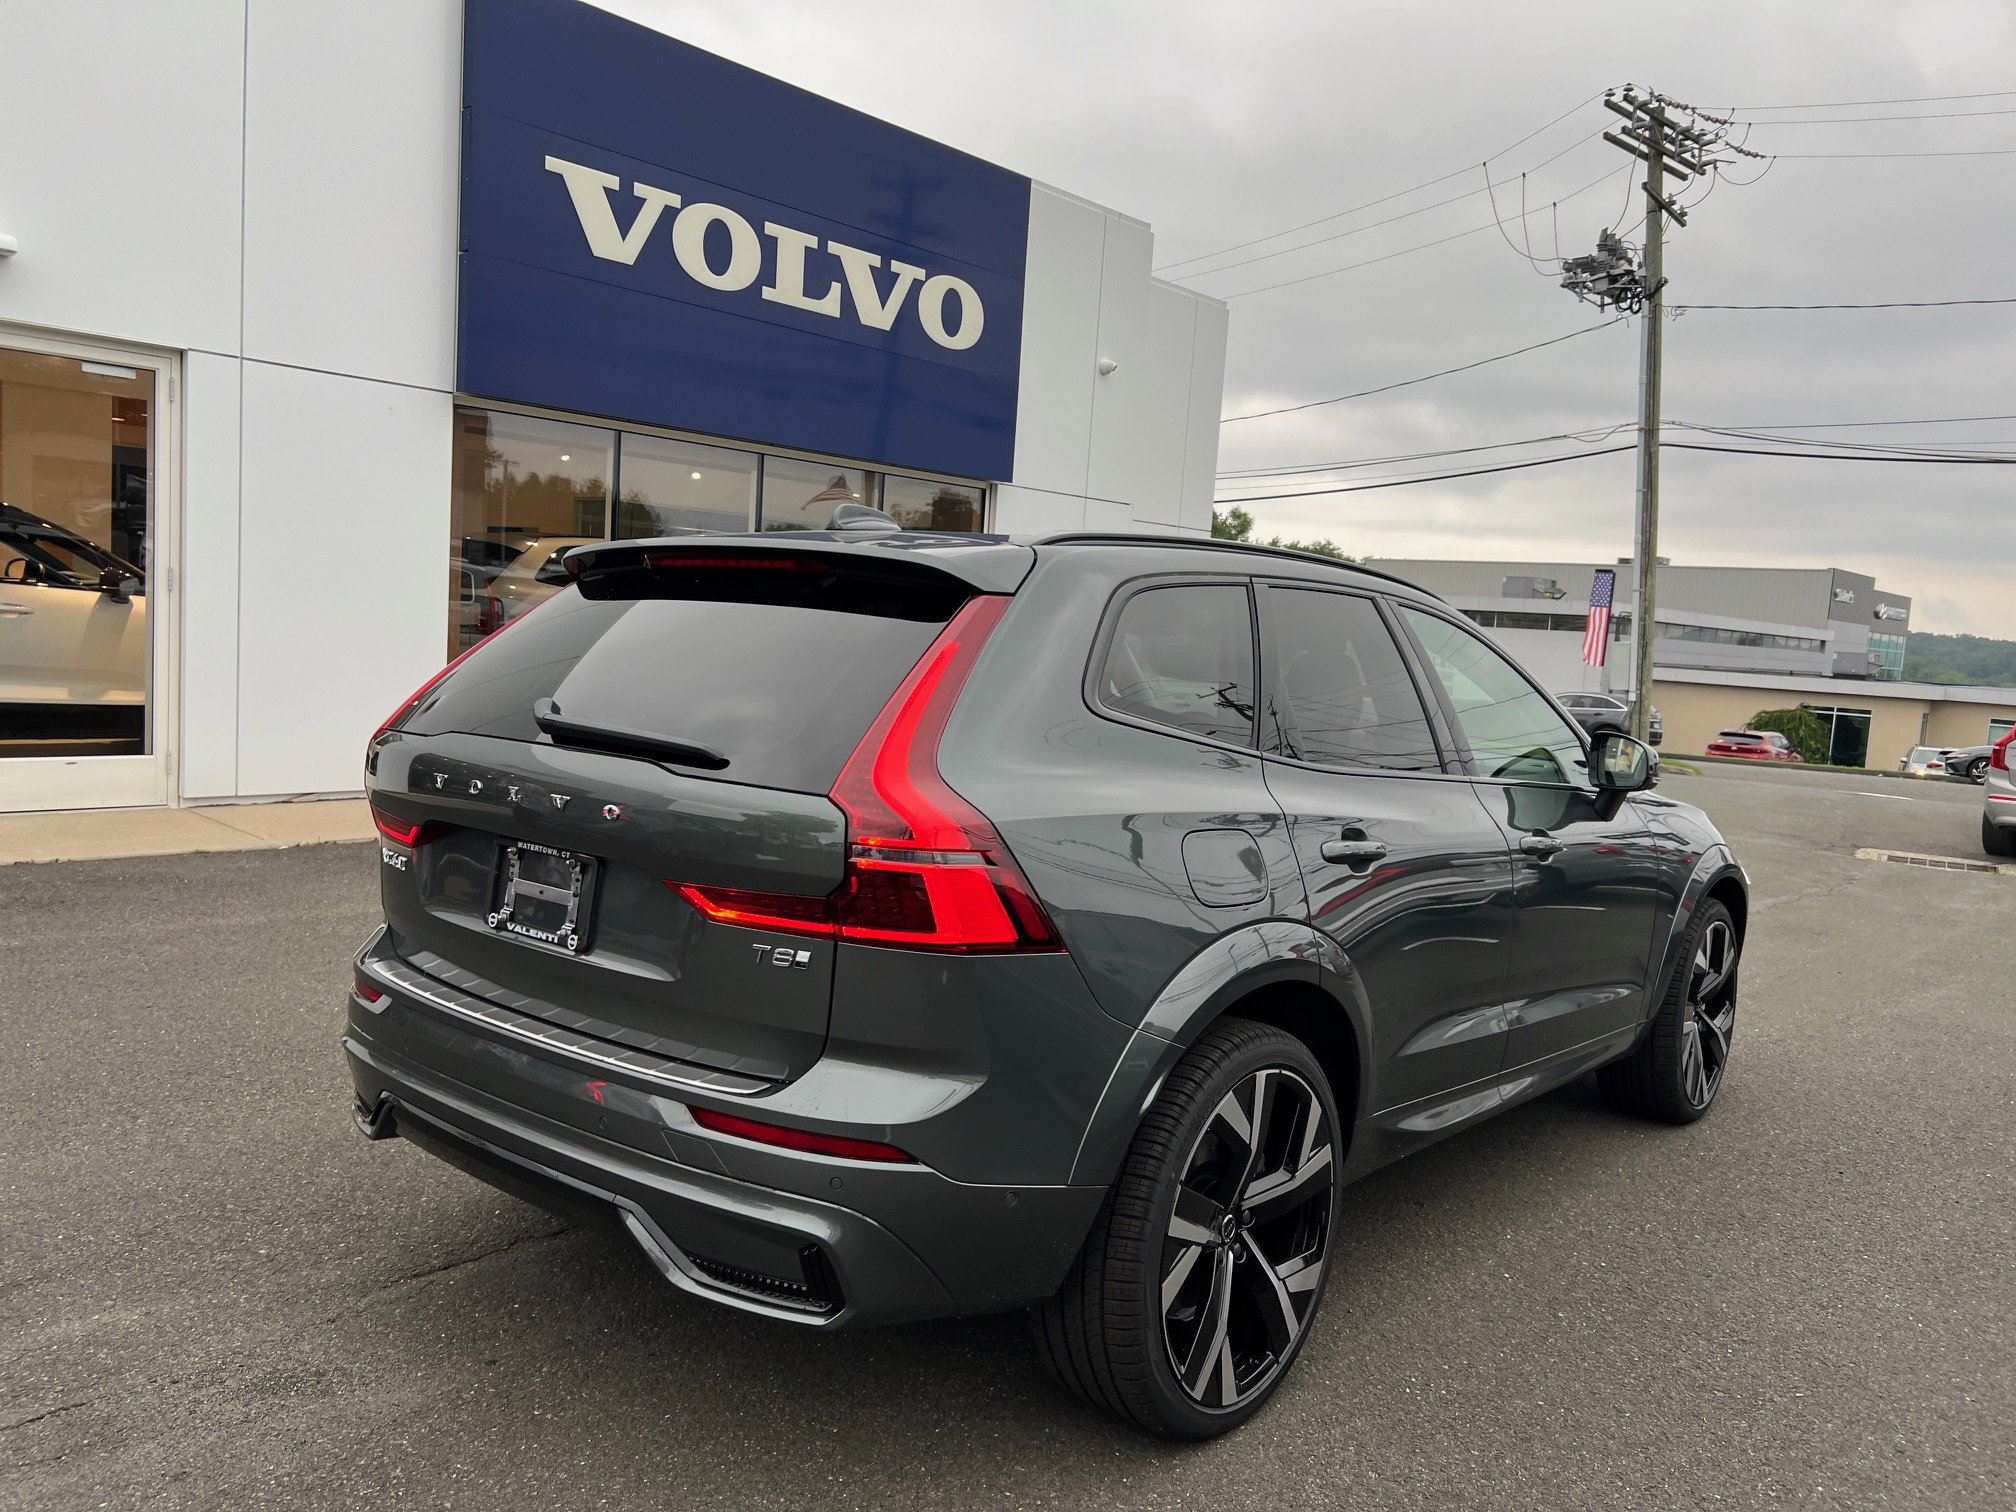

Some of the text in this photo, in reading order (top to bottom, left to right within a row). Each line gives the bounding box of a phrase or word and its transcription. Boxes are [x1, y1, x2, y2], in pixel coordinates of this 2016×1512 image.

[544, 155, 985, 350] VOLVO
[433, 773, 621, 820] VOLVO
[517, 841, 571, 859] WATERTOWN, CT
[506, 922, 559, 943] VALENTI
[752, 944, 795, 967] T8
